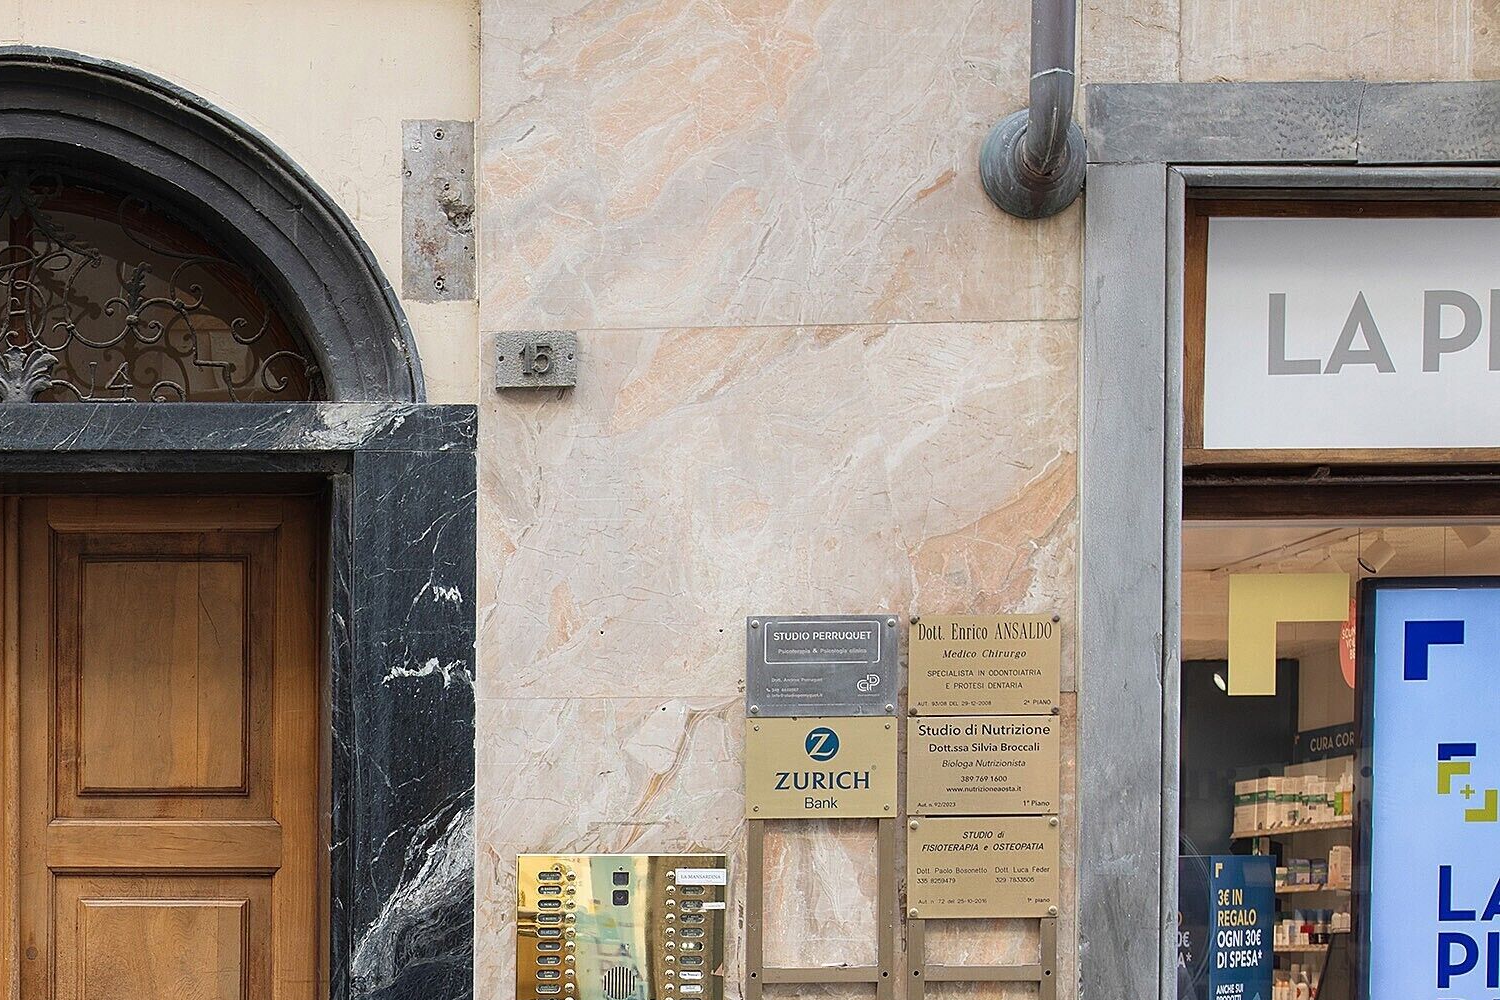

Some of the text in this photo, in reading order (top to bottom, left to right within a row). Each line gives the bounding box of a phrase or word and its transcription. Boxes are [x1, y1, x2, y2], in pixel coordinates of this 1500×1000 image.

[1268, 290, 1396, 375] LA
[518, 343, 554, 376] 15
[773, 630, 872, 641] STUDIO PERRUQUET
[918, 621, 1052, 641] Dott. Enrico ANSALDO
[942, 649, 1027, 659] Medico Chirurgo
[927, 669, 974, 677] SPECIALISTA
[988, 669, 1042, 677] ODONTOIATRIA
[953, 682, 985, 690] PROTESI
[918, 723, 1051, 736] Studio di Nutrizione
[929, 742, 1040, 753] Dott.ssa Silvia Broccali
[1310, 737, 1334, 752] CURA
[941, 759, 1026, 769] Biologa Nutrizionista
[774, 771, 870, 790] ZURICH
[804, 797, 838, 809] Bank
[962, 830, 1005, 839] STUDIO di
[921, 843, 979, 852] FISIOTERAPIA
[992, 842, 1044, 851] OSTEOPATIA
[1217, 888, 1243, 906] 3€ IN
[1217, 908, 1257, 927] REGALO
[1216, 928, 1262, 948] OGNI 30€
[1216, 951, 1228, 969] DI
[1215, 983, 1244, 995] ANCHE SUI
